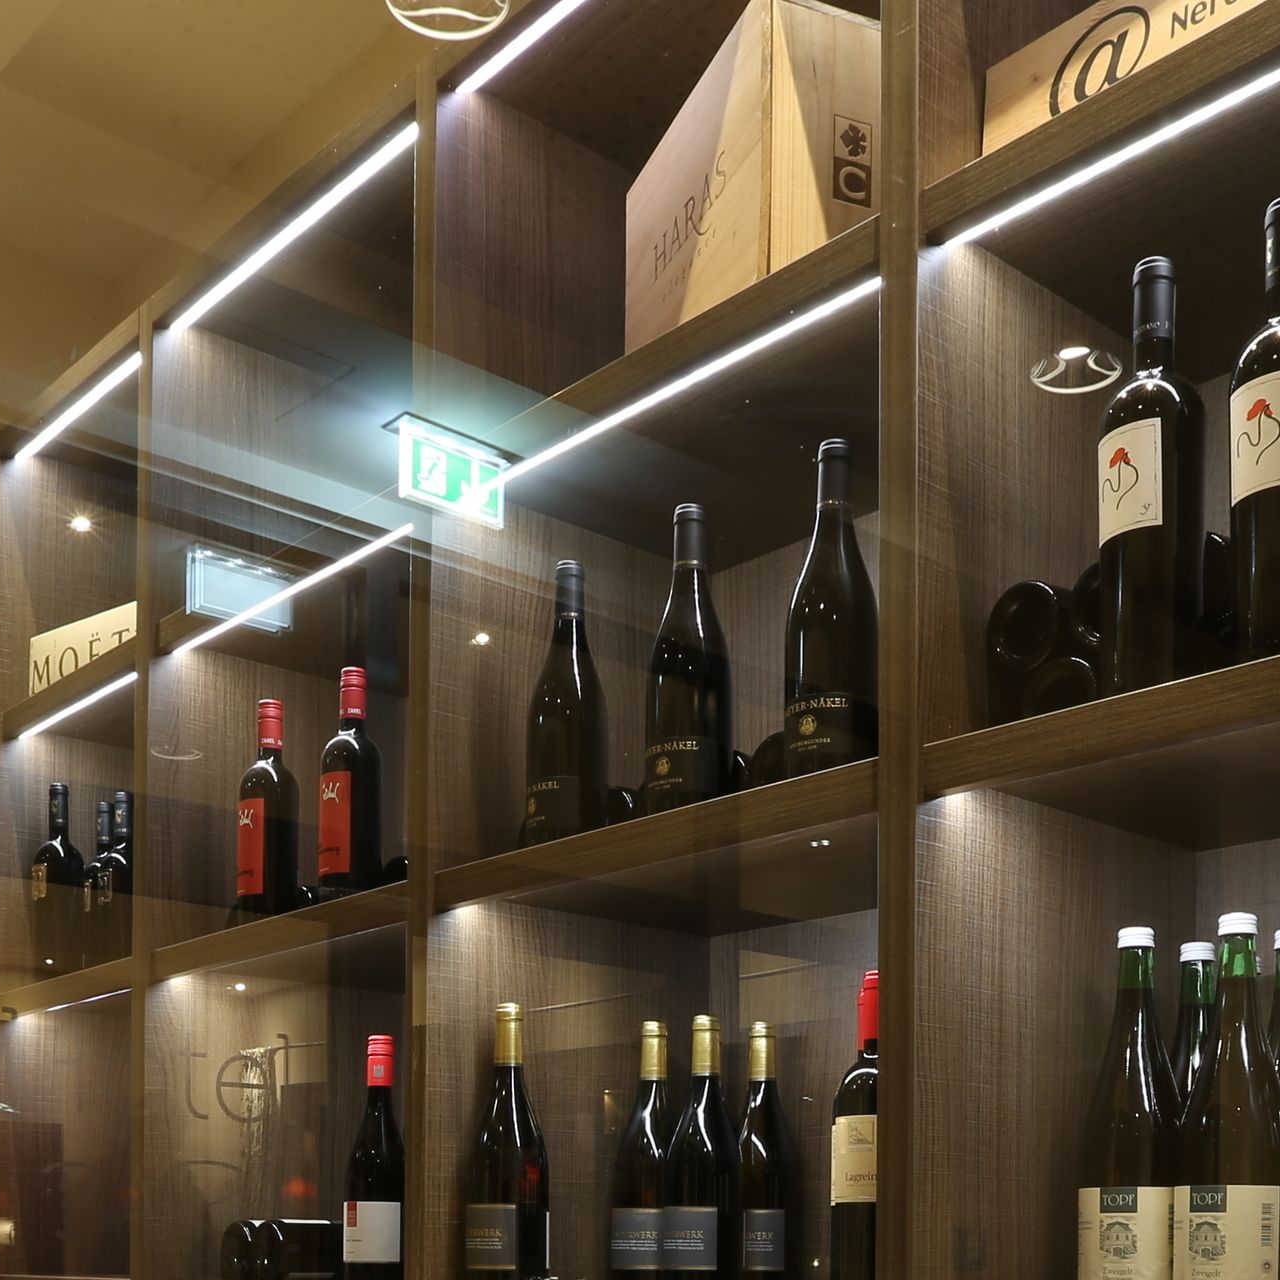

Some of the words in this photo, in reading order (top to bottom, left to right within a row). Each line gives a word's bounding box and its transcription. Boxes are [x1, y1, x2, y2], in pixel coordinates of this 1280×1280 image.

[1170, 0, 1237, 38] Ner
[838, 166, 867, 200] C
[651, 150, 727, 283] HARAS
[1102, 1193, 1136, 1207] TOPF
[1192, 1192, 1225, 1206] TOPF
